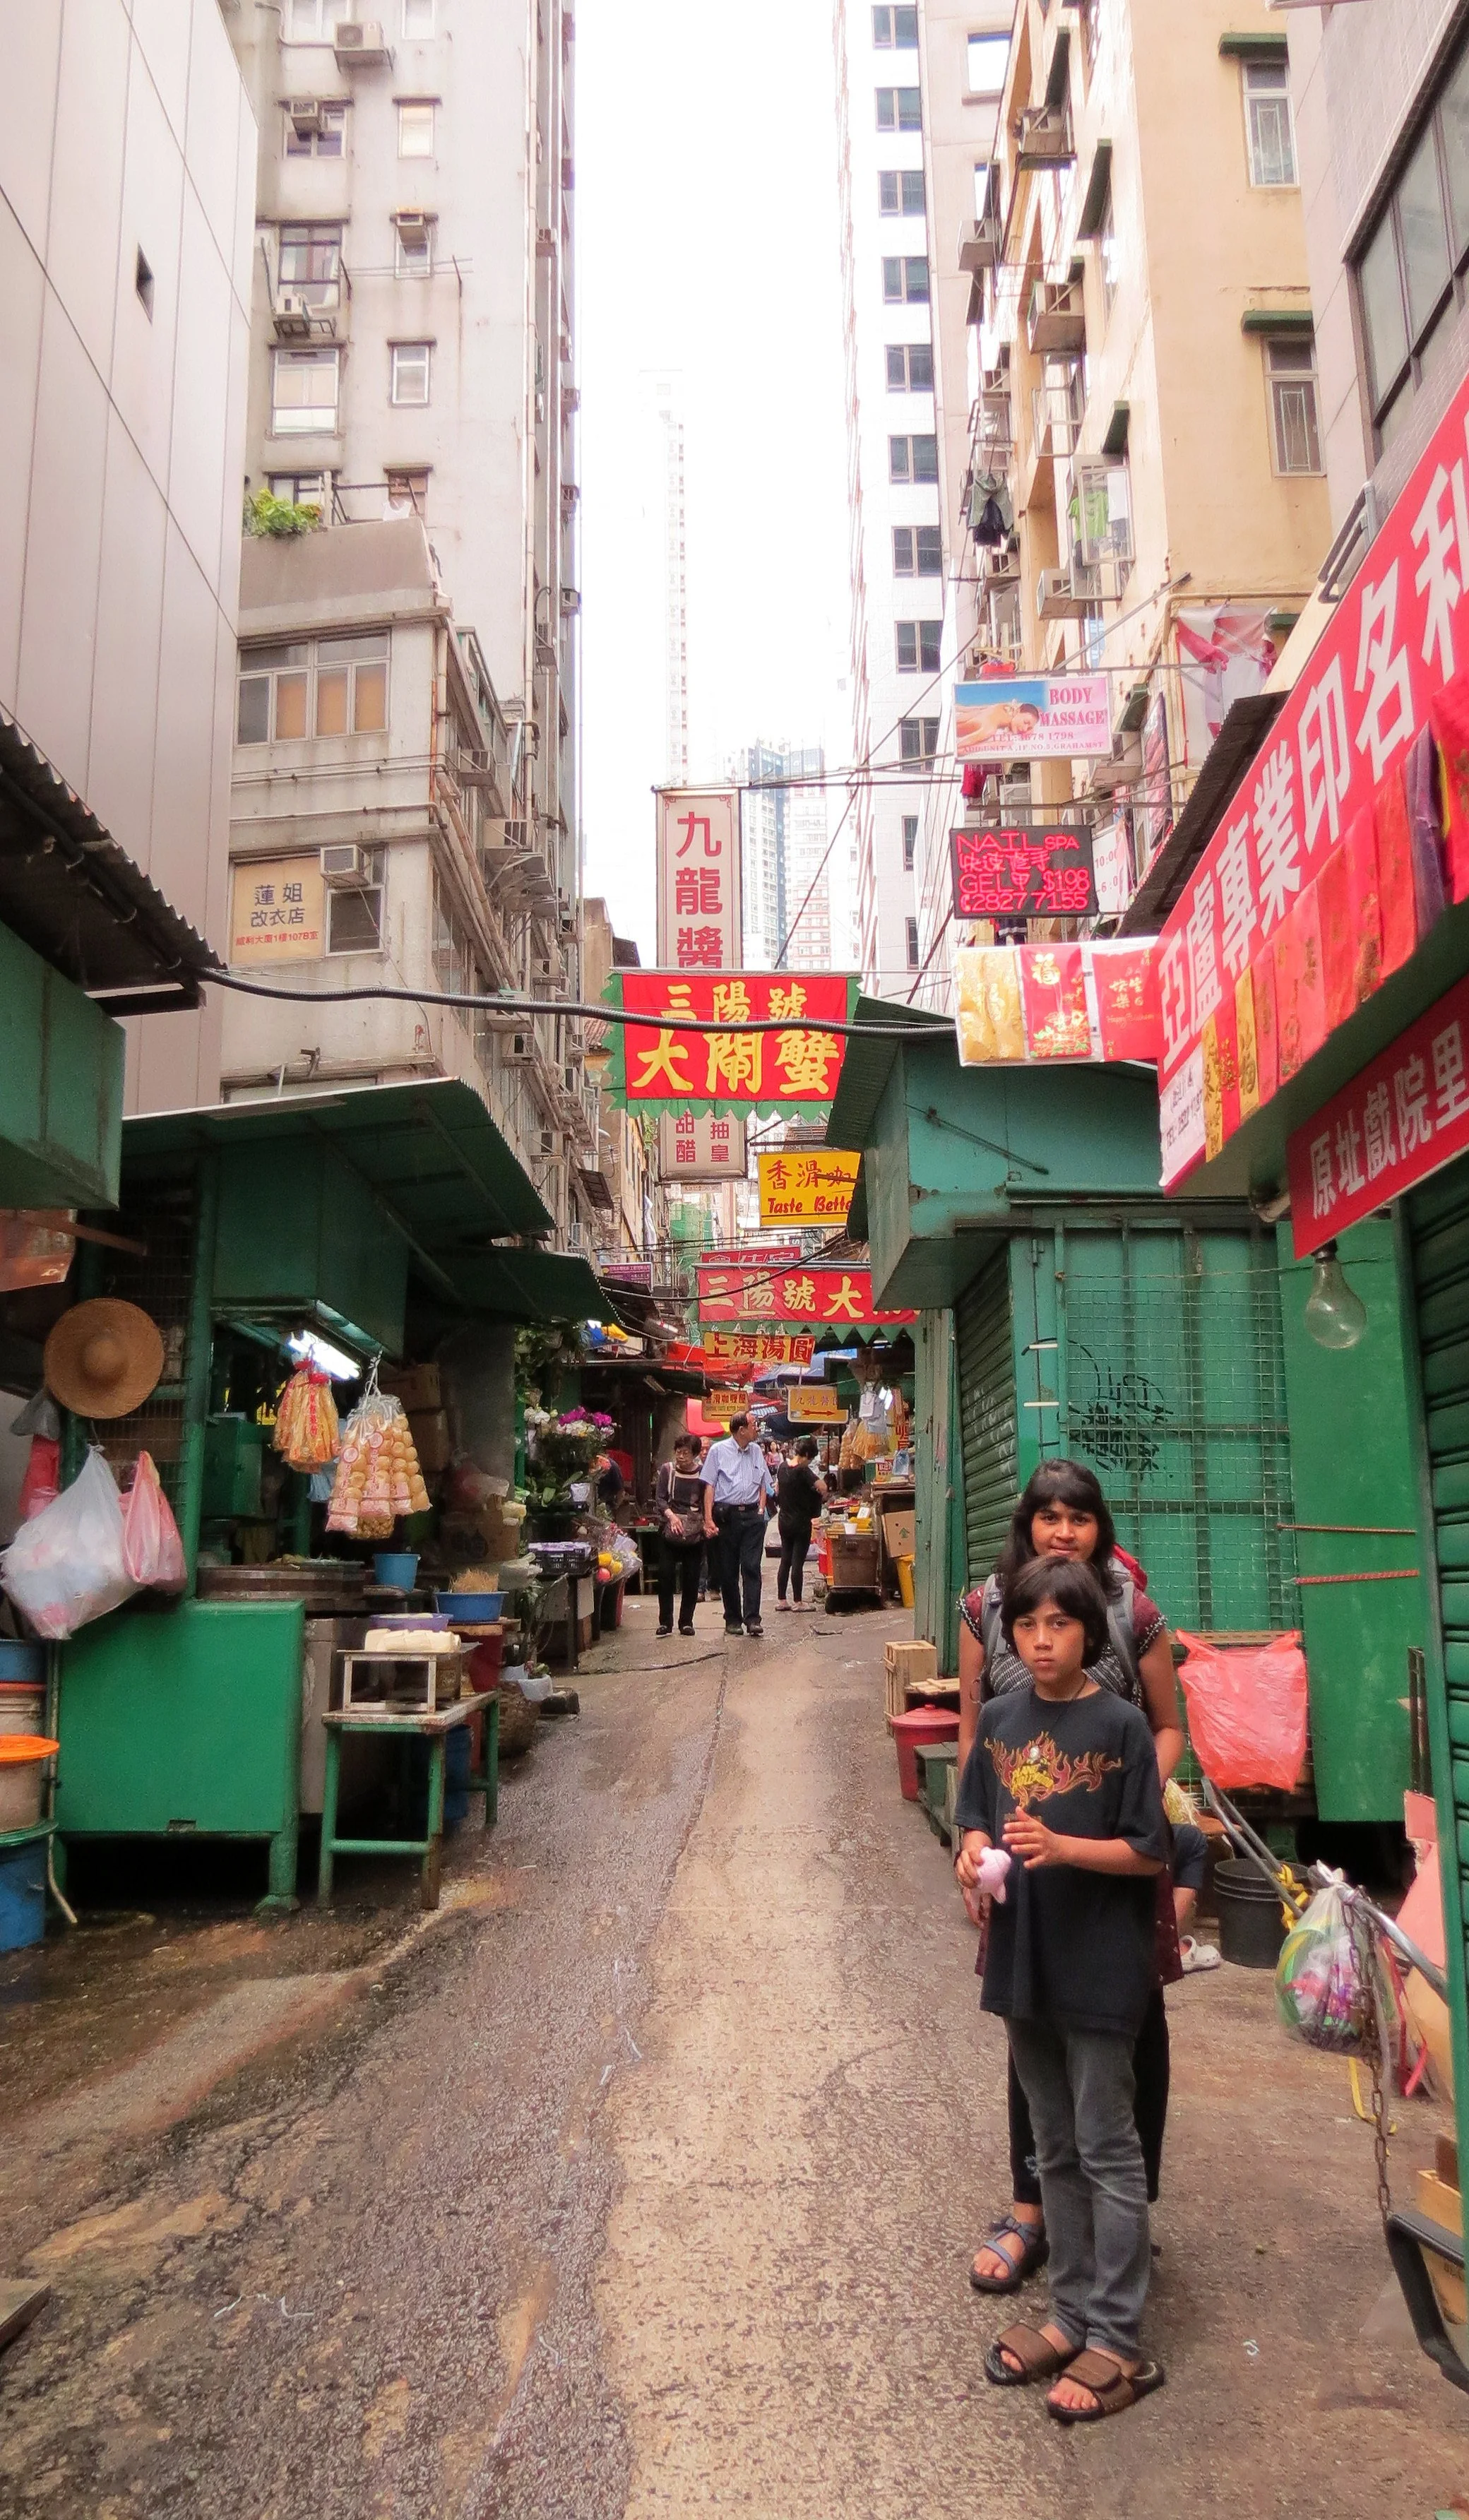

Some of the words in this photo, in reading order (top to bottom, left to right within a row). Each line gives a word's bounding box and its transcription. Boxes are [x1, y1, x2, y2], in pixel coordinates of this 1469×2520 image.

[1049, 687, 1093, 705] BODY
[1039, 710, 1105, 727] MASSAGE
[1047, 731, 1074, 741] 1798
[957, 831, 1044, 853] NAIL
[1044, 834, 1080, 850] SPA
[676, 811, 723, 968] 九龍醬
[1043, 867, 1090, 893] $198
[972, 891, 1028, 911] 2827
[1030, 891, 1089, 910] 7155
[251, 907, 306, 927] 改衣店
[660, 980, 807, 1025] 三陽號
[631, 1026, 840, 1094] 大閘蟹
[1310, 1021, 1469, 1220] 原址戲院里
[676, 1111, 696, 1163] 甜醋
[710, 1114, 730, 1163] 抽皇
[768, 1197, 803, 1214] Taste
[700, 1271, 921, 1319] 三陽號大
[707, 1332, 814, 1365] 上海湯圓
